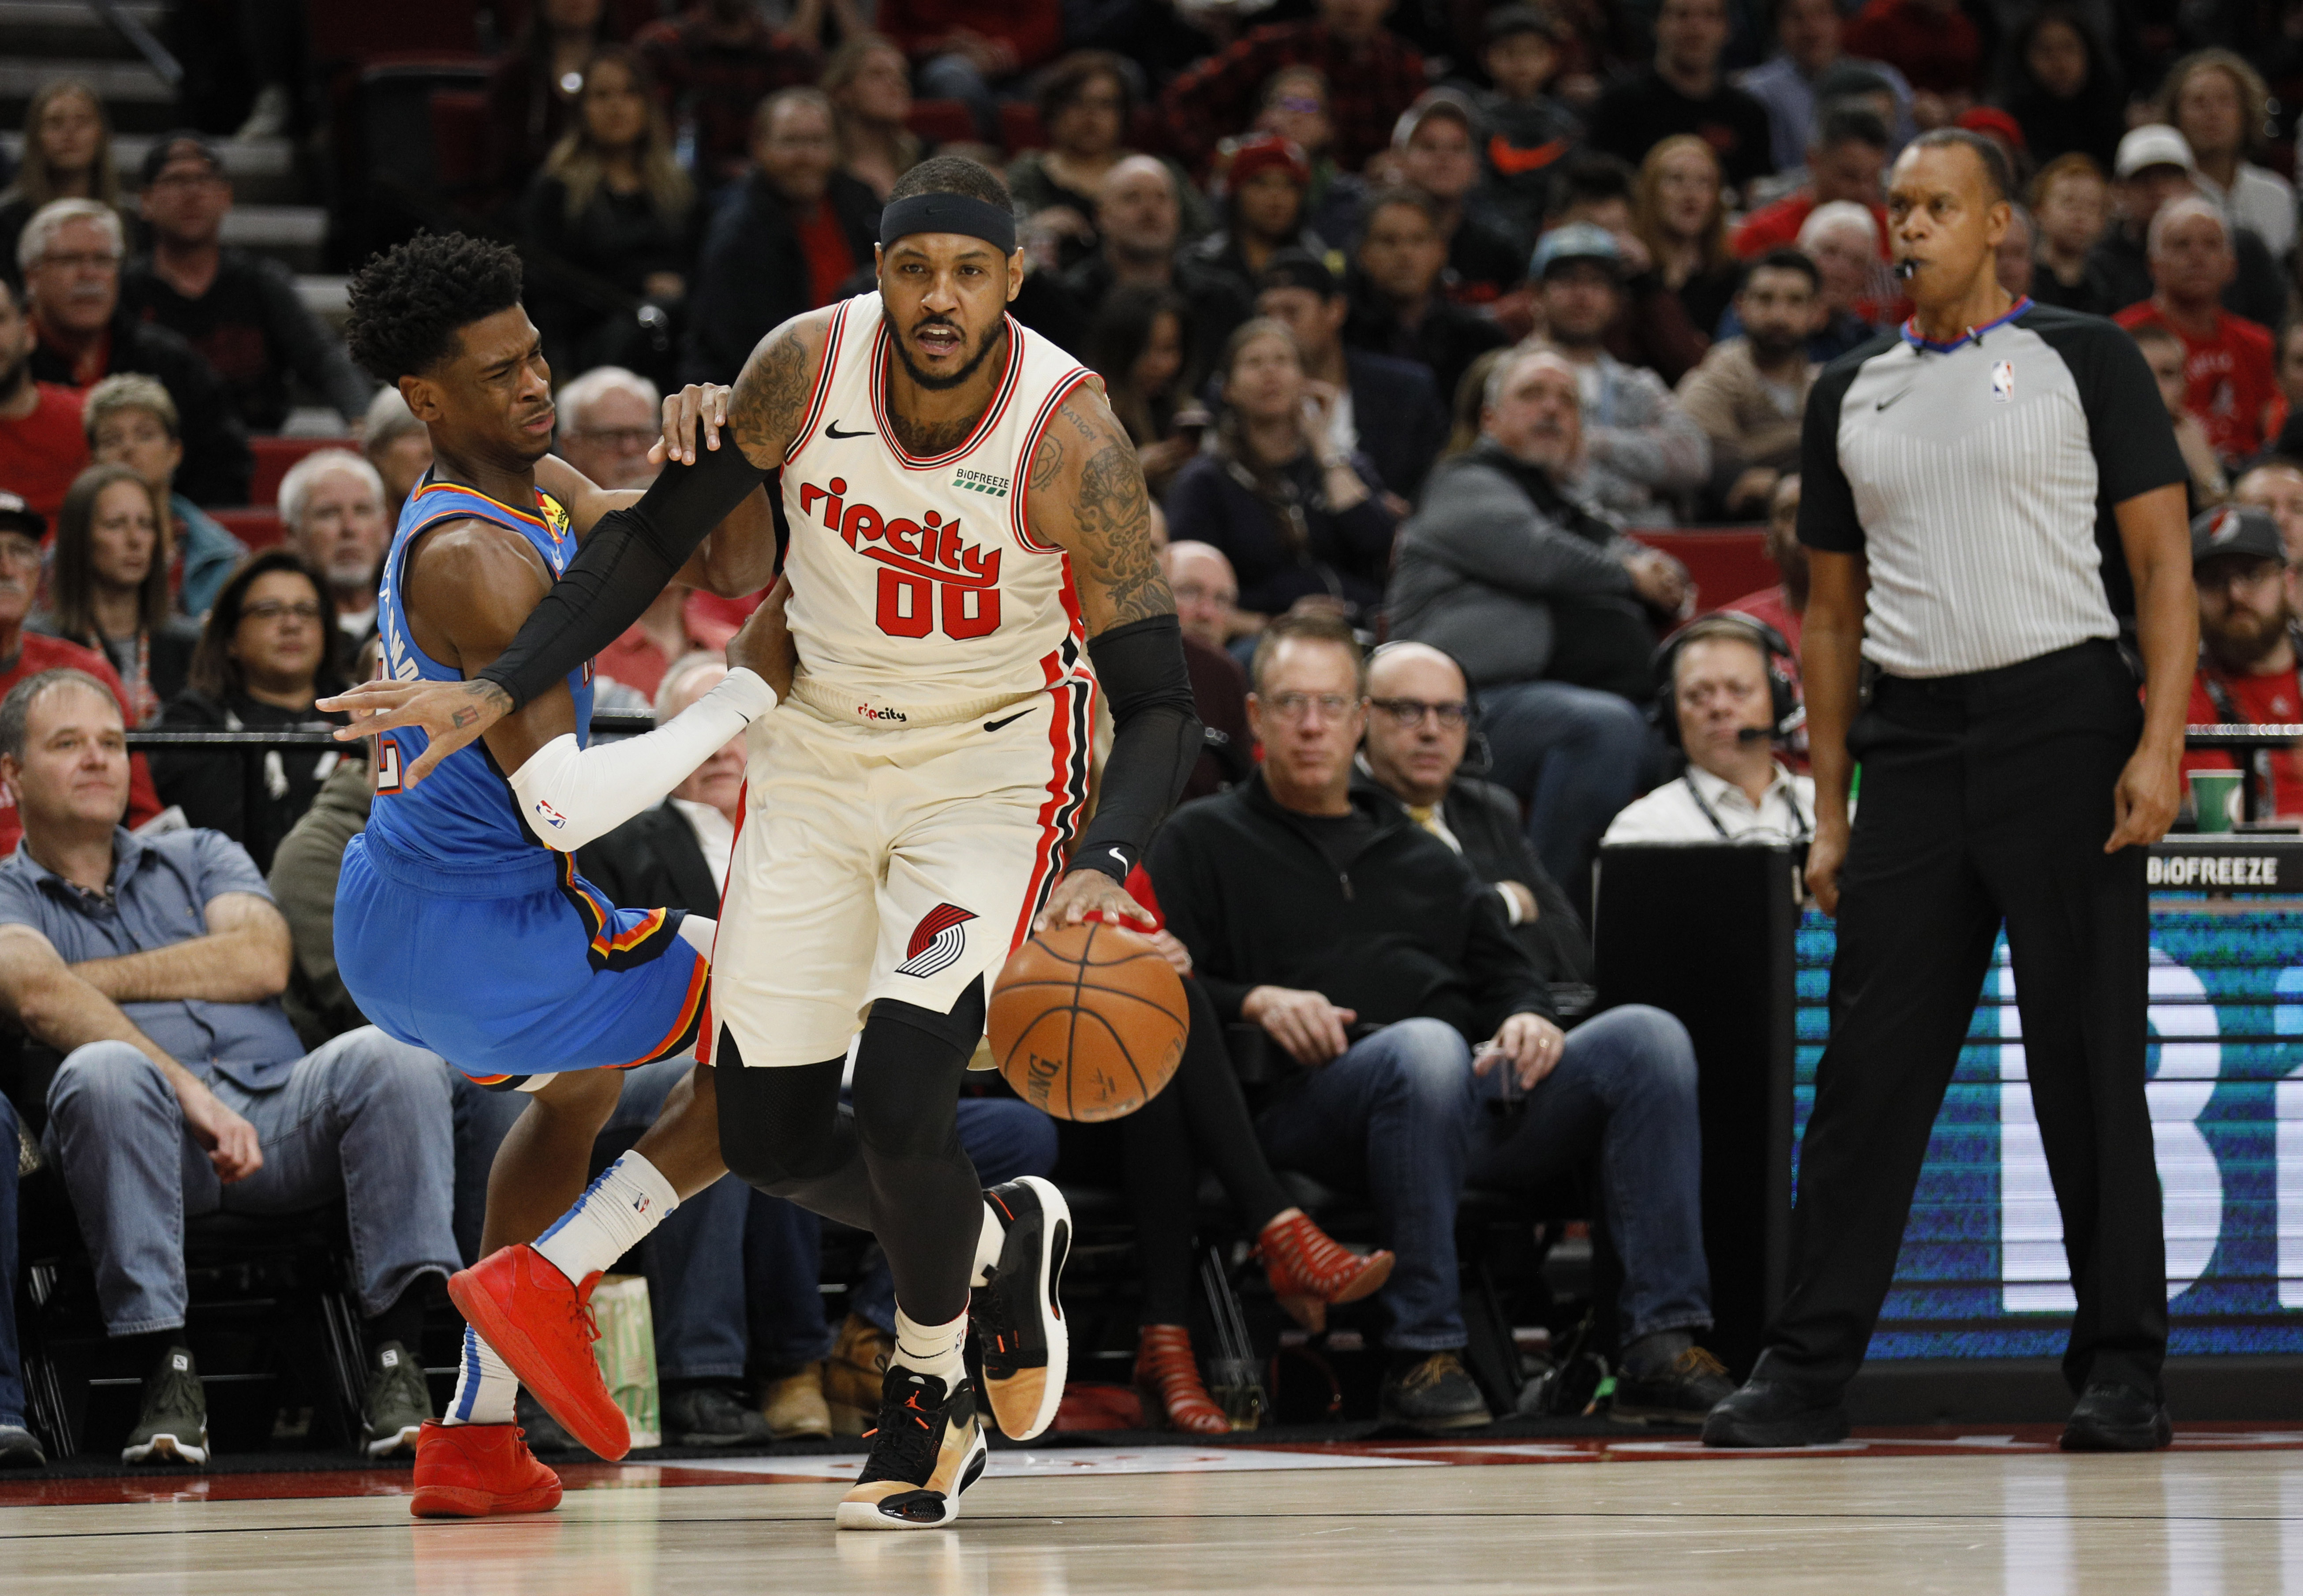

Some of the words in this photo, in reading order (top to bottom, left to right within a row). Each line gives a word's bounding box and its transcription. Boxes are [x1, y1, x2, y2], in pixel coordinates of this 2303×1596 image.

[800, 477, 1002, 588] ripcity
[876, 566, 1001, 641] 00
[858, 703, 907, 722] ripcity
